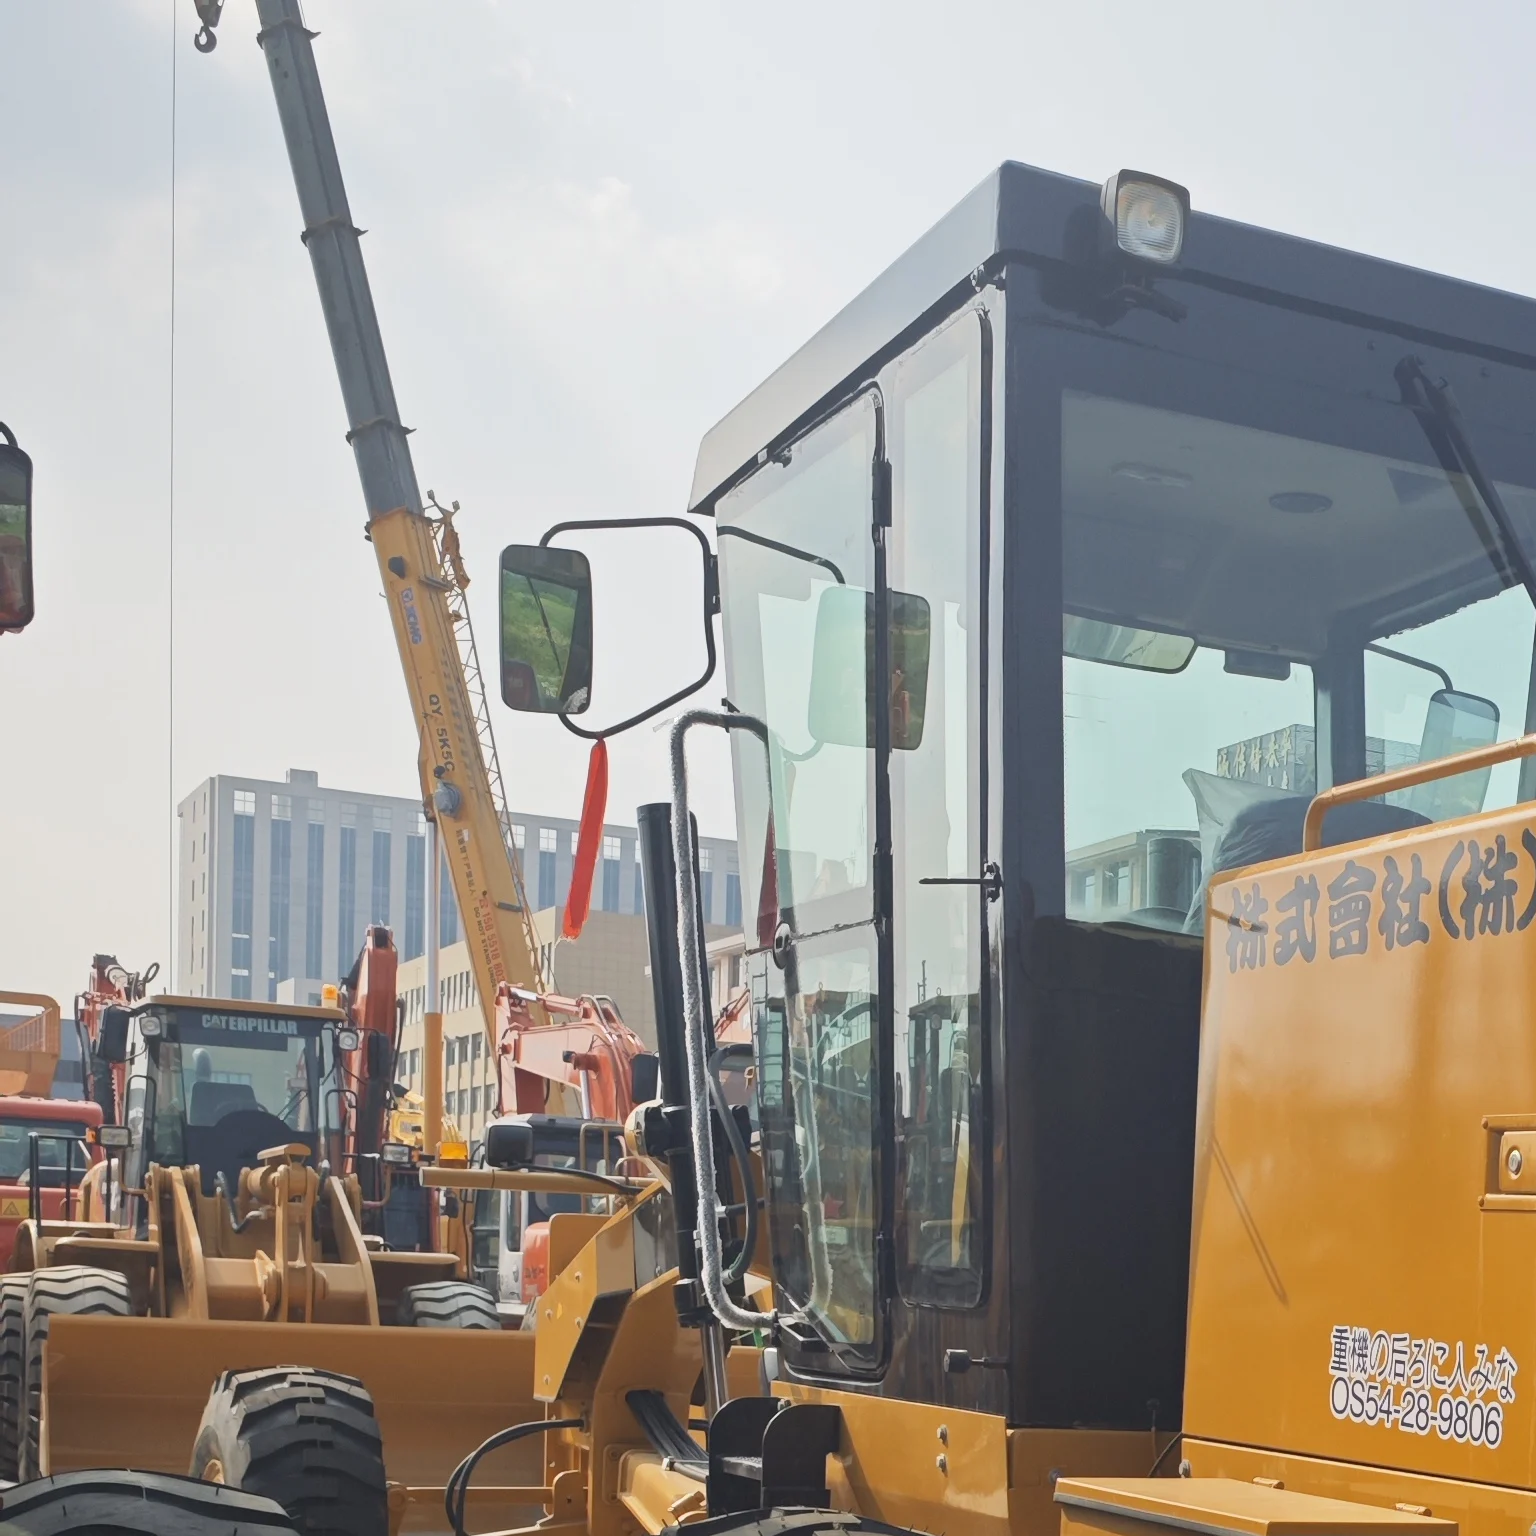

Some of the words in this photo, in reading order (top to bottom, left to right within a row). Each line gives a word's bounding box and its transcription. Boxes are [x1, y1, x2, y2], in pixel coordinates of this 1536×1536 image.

[428, 693, 443, 717] QY
[476, 920, 486, 937] NOT
[481, 937, 492, 966] STAND
[201, 1013, 298, 1035] CATERPILLAR
